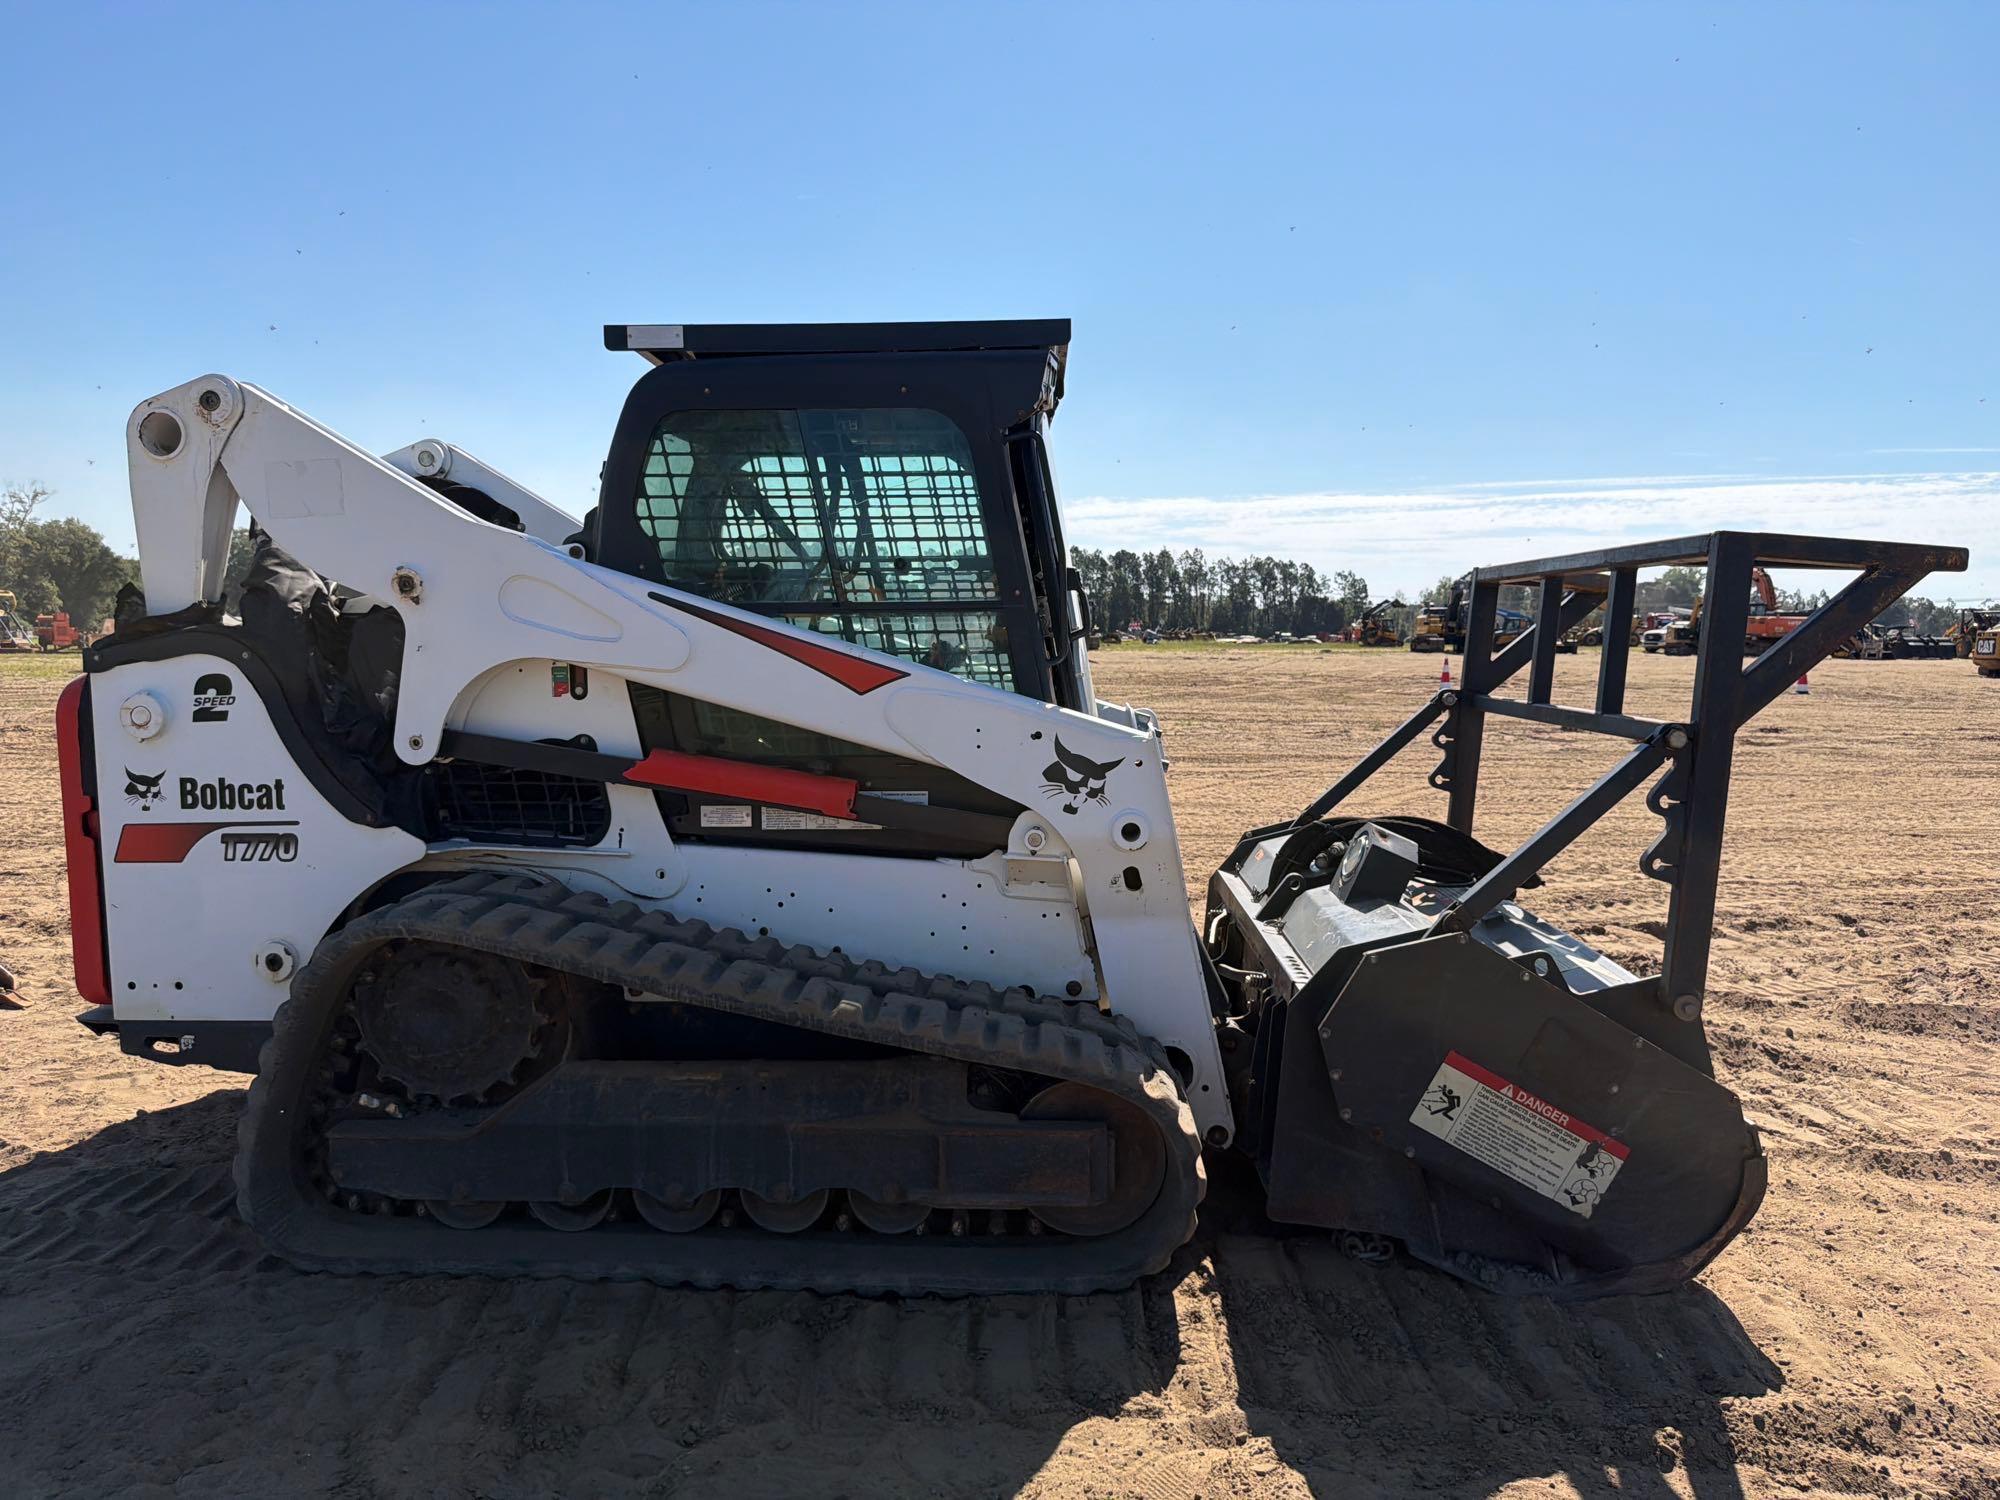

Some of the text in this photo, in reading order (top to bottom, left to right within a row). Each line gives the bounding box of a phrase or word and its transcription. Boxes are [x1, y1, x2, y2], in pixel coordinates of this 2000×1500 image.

[1978, 640, 1995, 654] CAT
[192, 673, 233, 722] 2
[193, 696, 236, 706] SPEED
[179, 777, 285, 810] Bobcat
[220, 833, 299, 862] T770
[1480, 1086, 1504, 1101] THROWN
[1503, 1098, 1529, 1115] OBJECTS
[1537, 1117, 1563, 1134] ROTATING
[1516, 1090, 1570, 1126] DANGER
